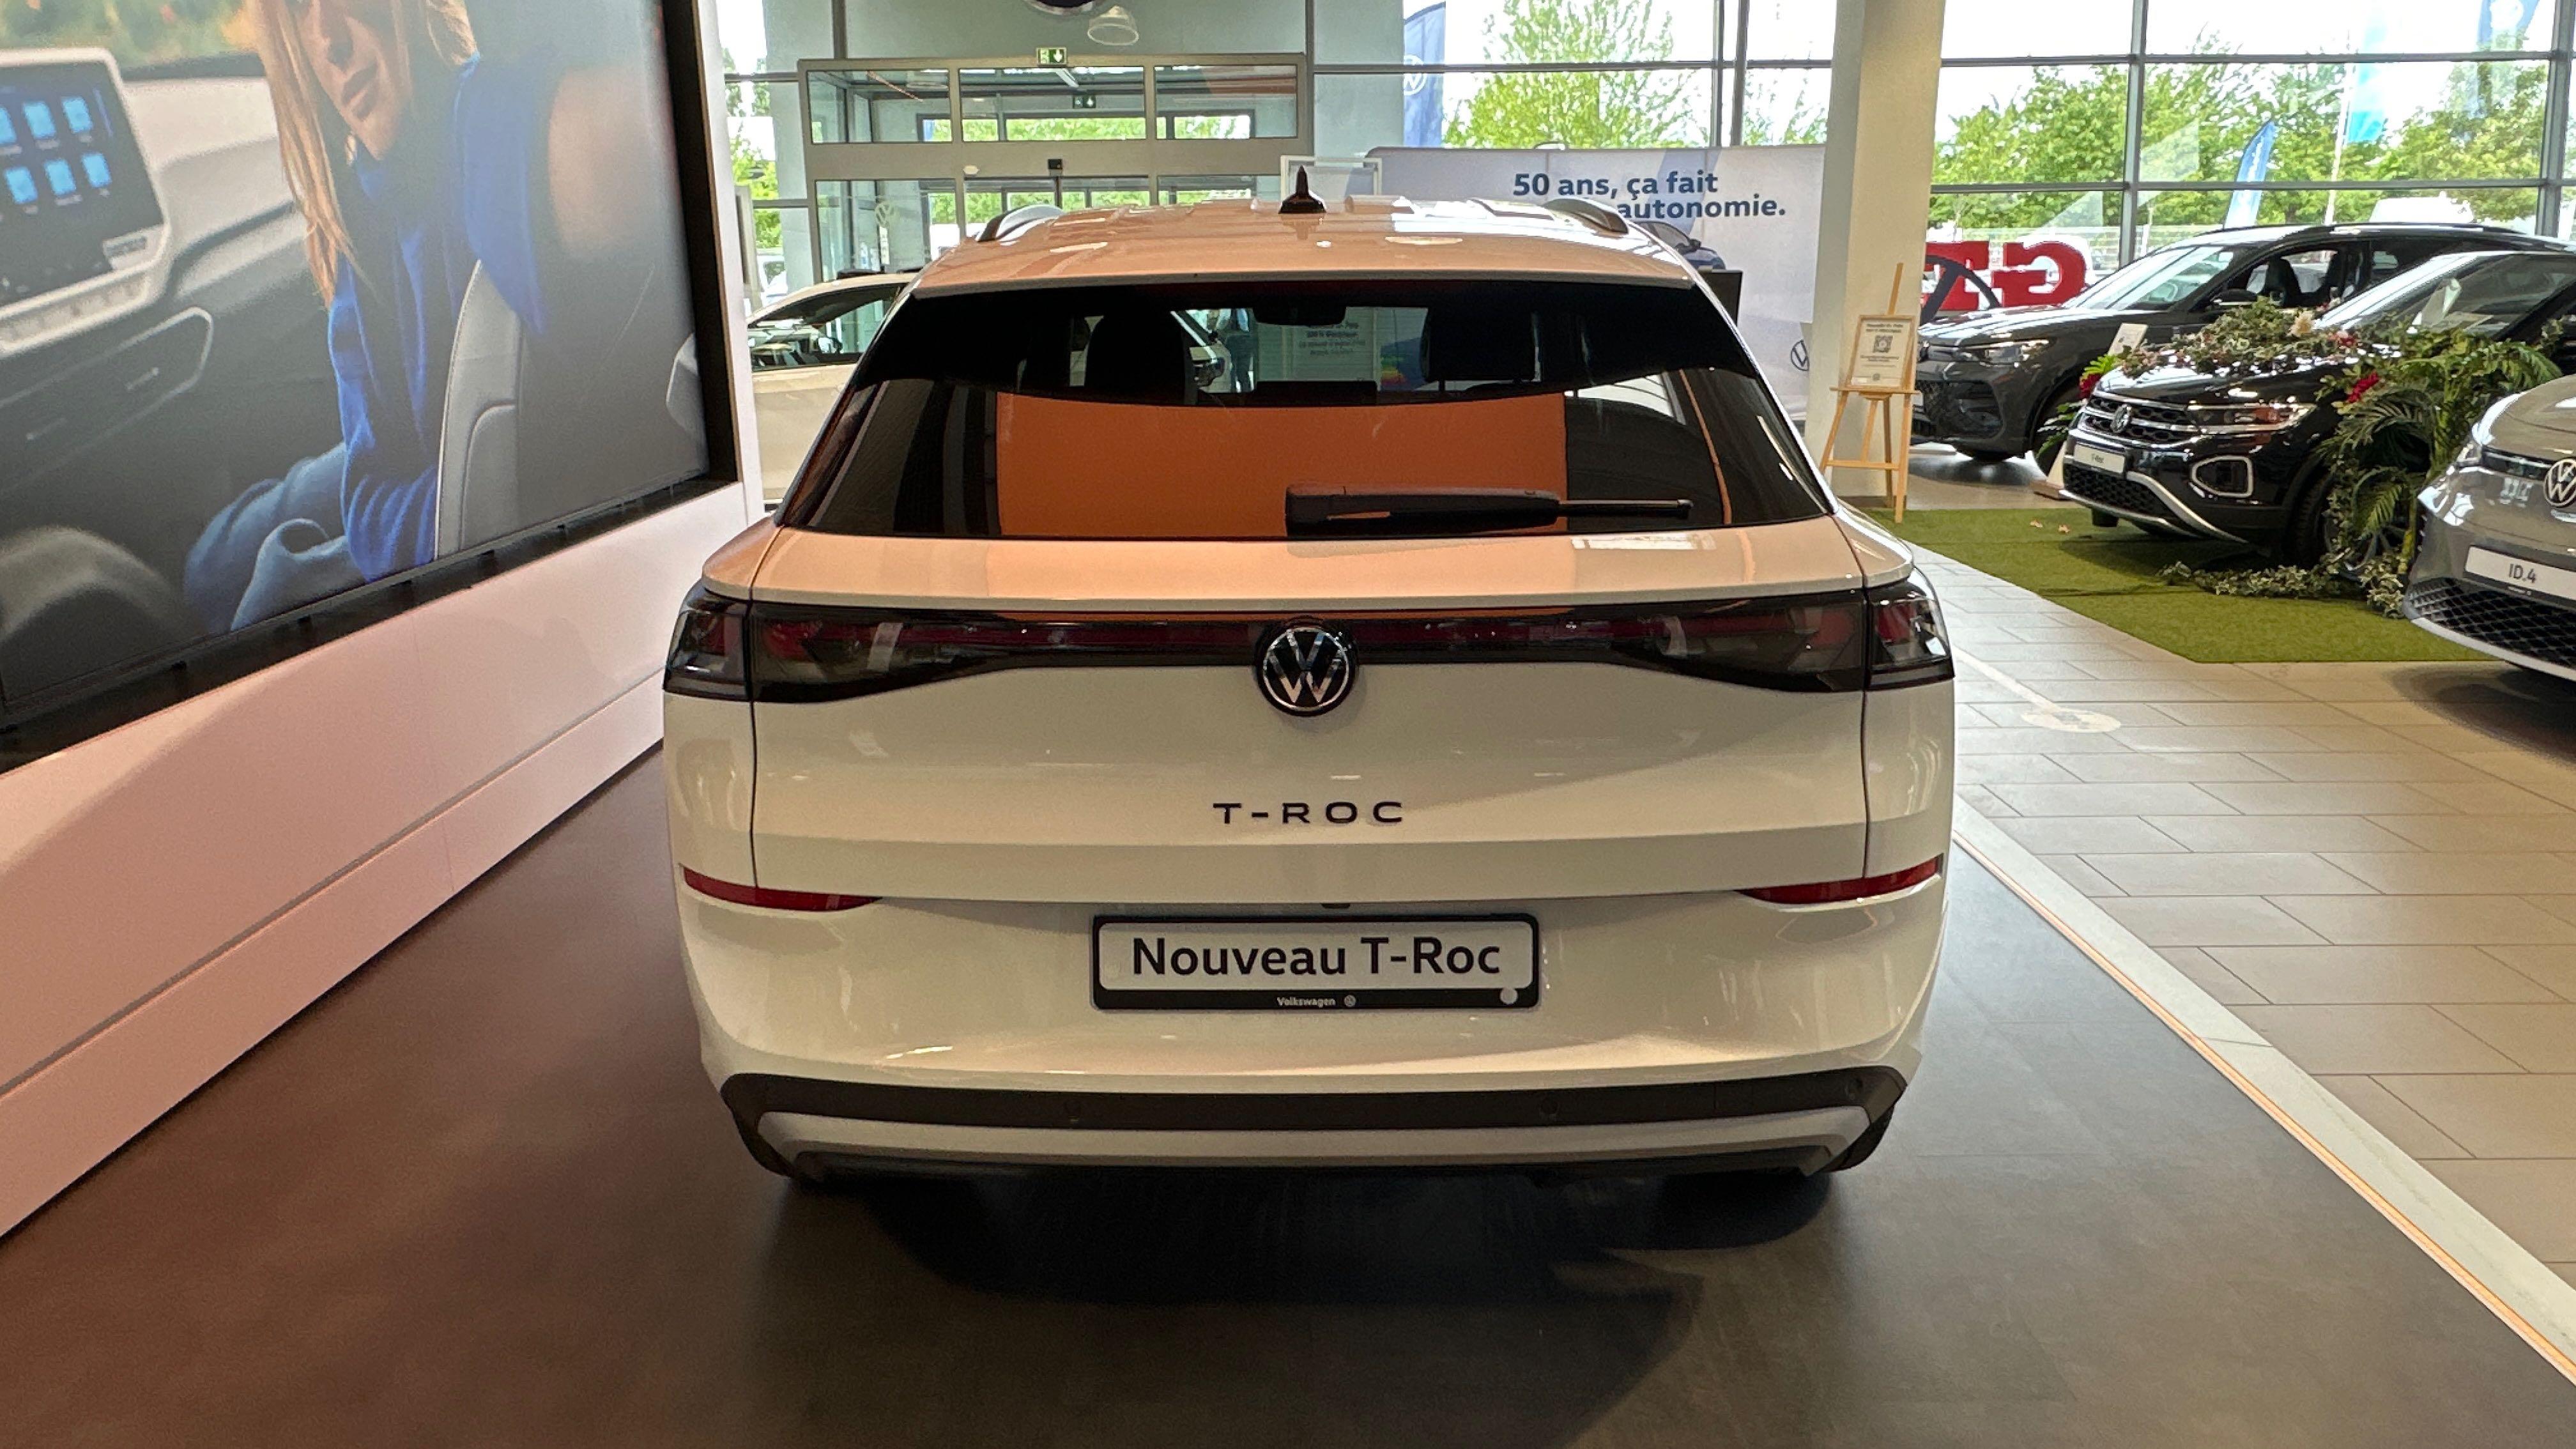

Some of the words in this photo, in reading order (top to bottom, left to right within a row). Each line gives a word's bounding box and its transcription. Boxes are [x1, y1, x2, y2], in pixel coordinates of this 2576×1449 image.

[1513, 173, 1550, 196] 50
[1558, 176, 1618, 199] ans,
[1627, 176, 1659, 201] ça
[1666, 169, 1719, 194] fait
[1617, 194, 1786, 219] autonomie.
[2508, 563, 2537, 584] ID.4
[1212, 801, 1404, 825] T-ROC
[1132, 936, 1347, 976] Nouveau
[1359, 935, 1501, 976] T-Roc
[1276, 996, 1337, 1008] Volkswagen
